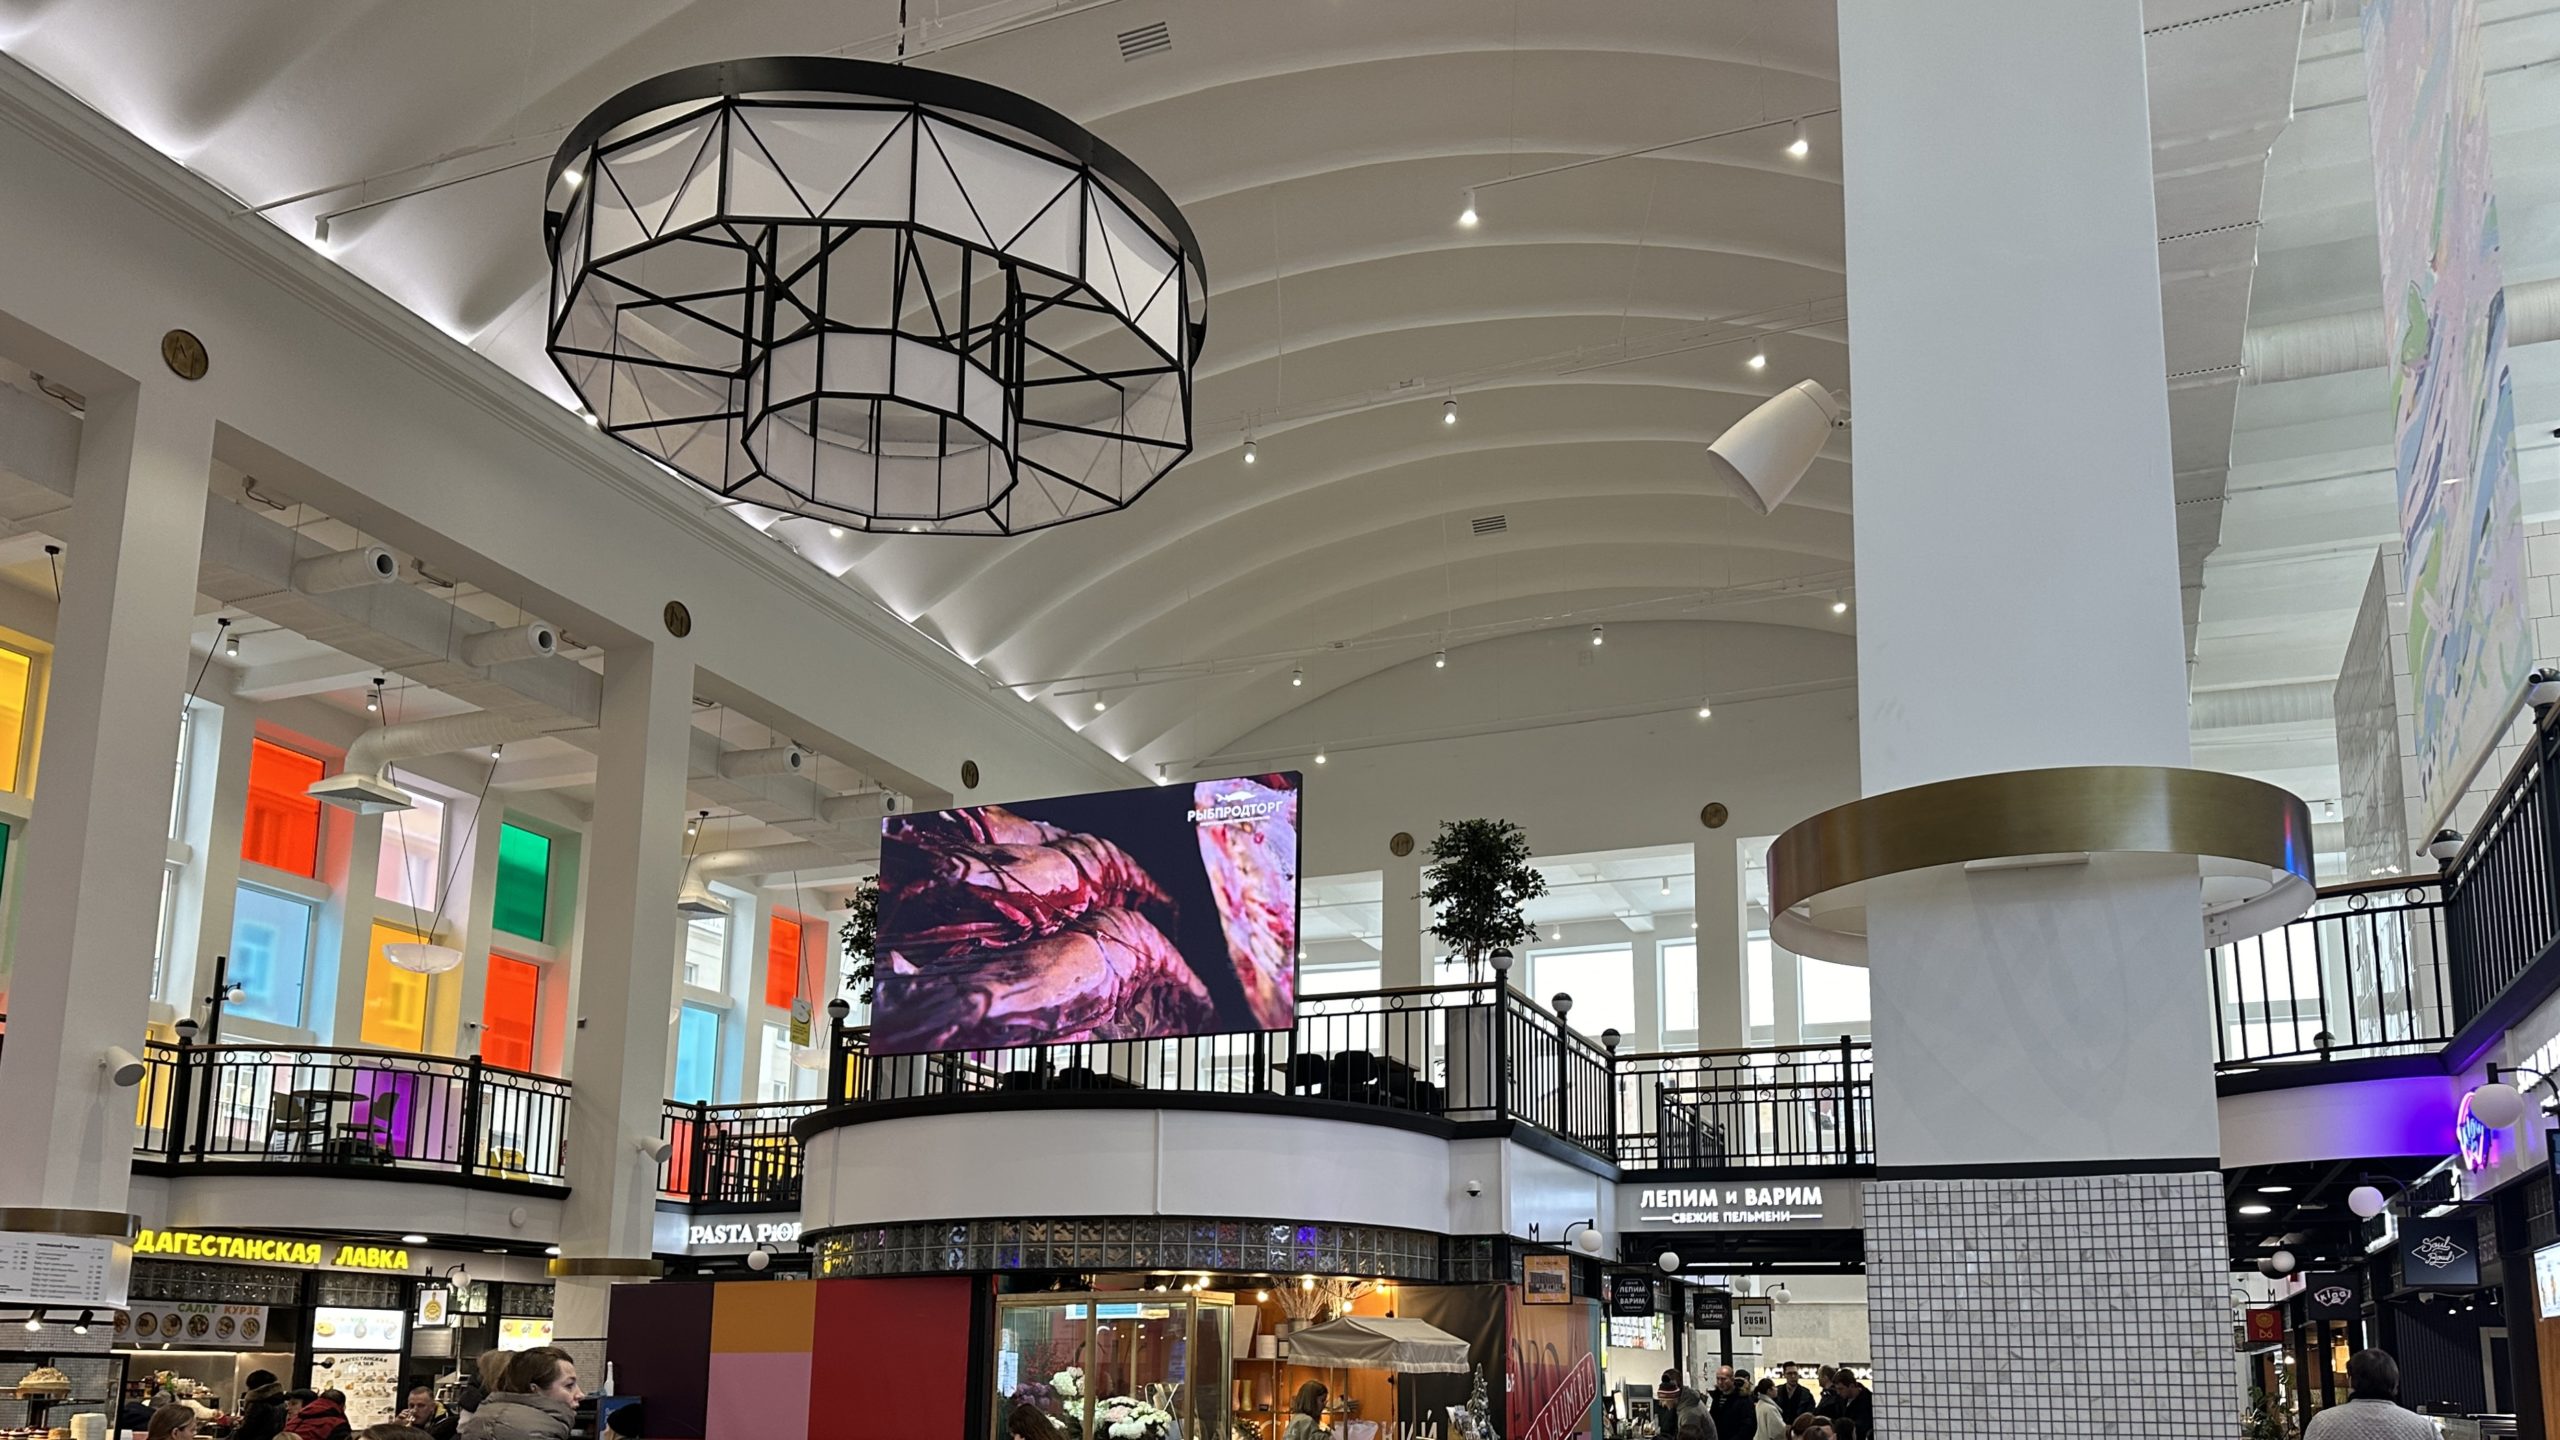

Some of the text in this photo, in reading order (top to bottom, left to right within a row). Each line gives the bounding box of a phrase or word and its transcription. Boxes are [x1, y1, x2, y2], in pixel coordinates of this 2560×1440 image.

[1187, 801, 1283, 822] РЫБПРОДТОРГ
[1640, 1186, 1823, 1208] ЛЕПИМ и ВАРИМ
[1671, 1210, 1791, 1223] СВЕЖИЕ ПЕЛЬМЕНИ
[689, 1225, 754, 1244] PASTA
[132, 1229, 409, 1270] ДАГЕСТАНСКАЯ ЛАВКА
[177, 1303, 217, 1314] САЛАТ
[223, 1305, 261, 1316] КУРЗЕ
[1619, 1297, 1646, 1305] ВАРИМ
[1743, 1316, 1768, 1325] SUSHI
[1544, 1360, 1596, 1440] SALUMERIA
